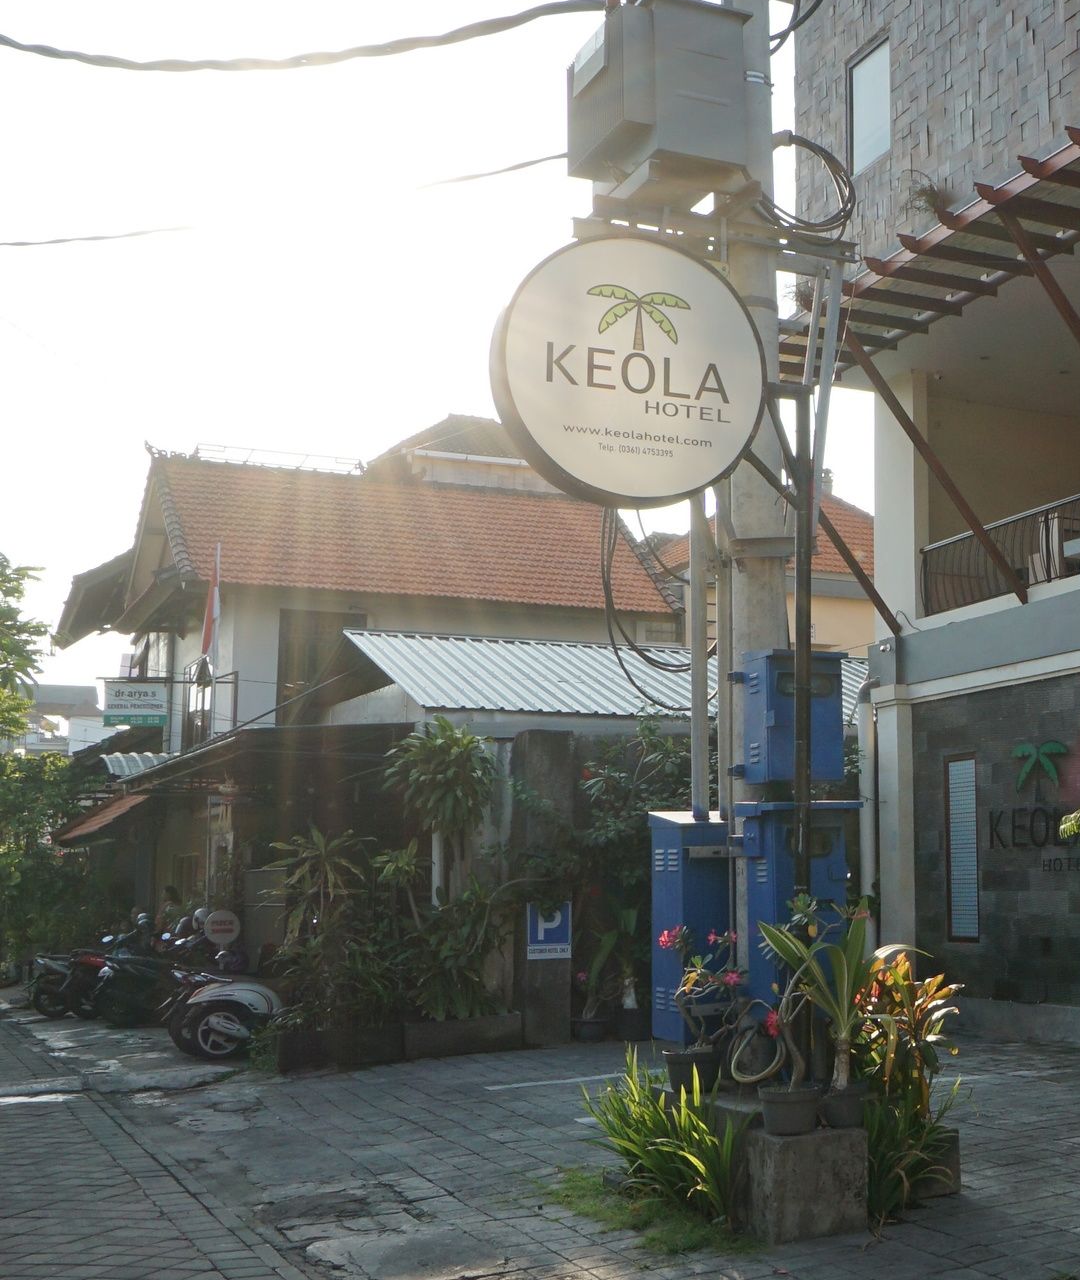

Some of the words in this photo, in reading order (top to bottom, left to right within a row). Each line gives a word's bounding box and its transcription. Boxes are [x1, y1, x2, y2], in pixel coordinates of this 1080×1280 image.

[545, 341, 730, 404] KEOLA
[645, 400, 731, 423] HOTEL
[563, 424, 713, 448] www.keolahotel.com
[618, 444, 641, 455] (0361)
[642, 447, 674, 458] 4753395
